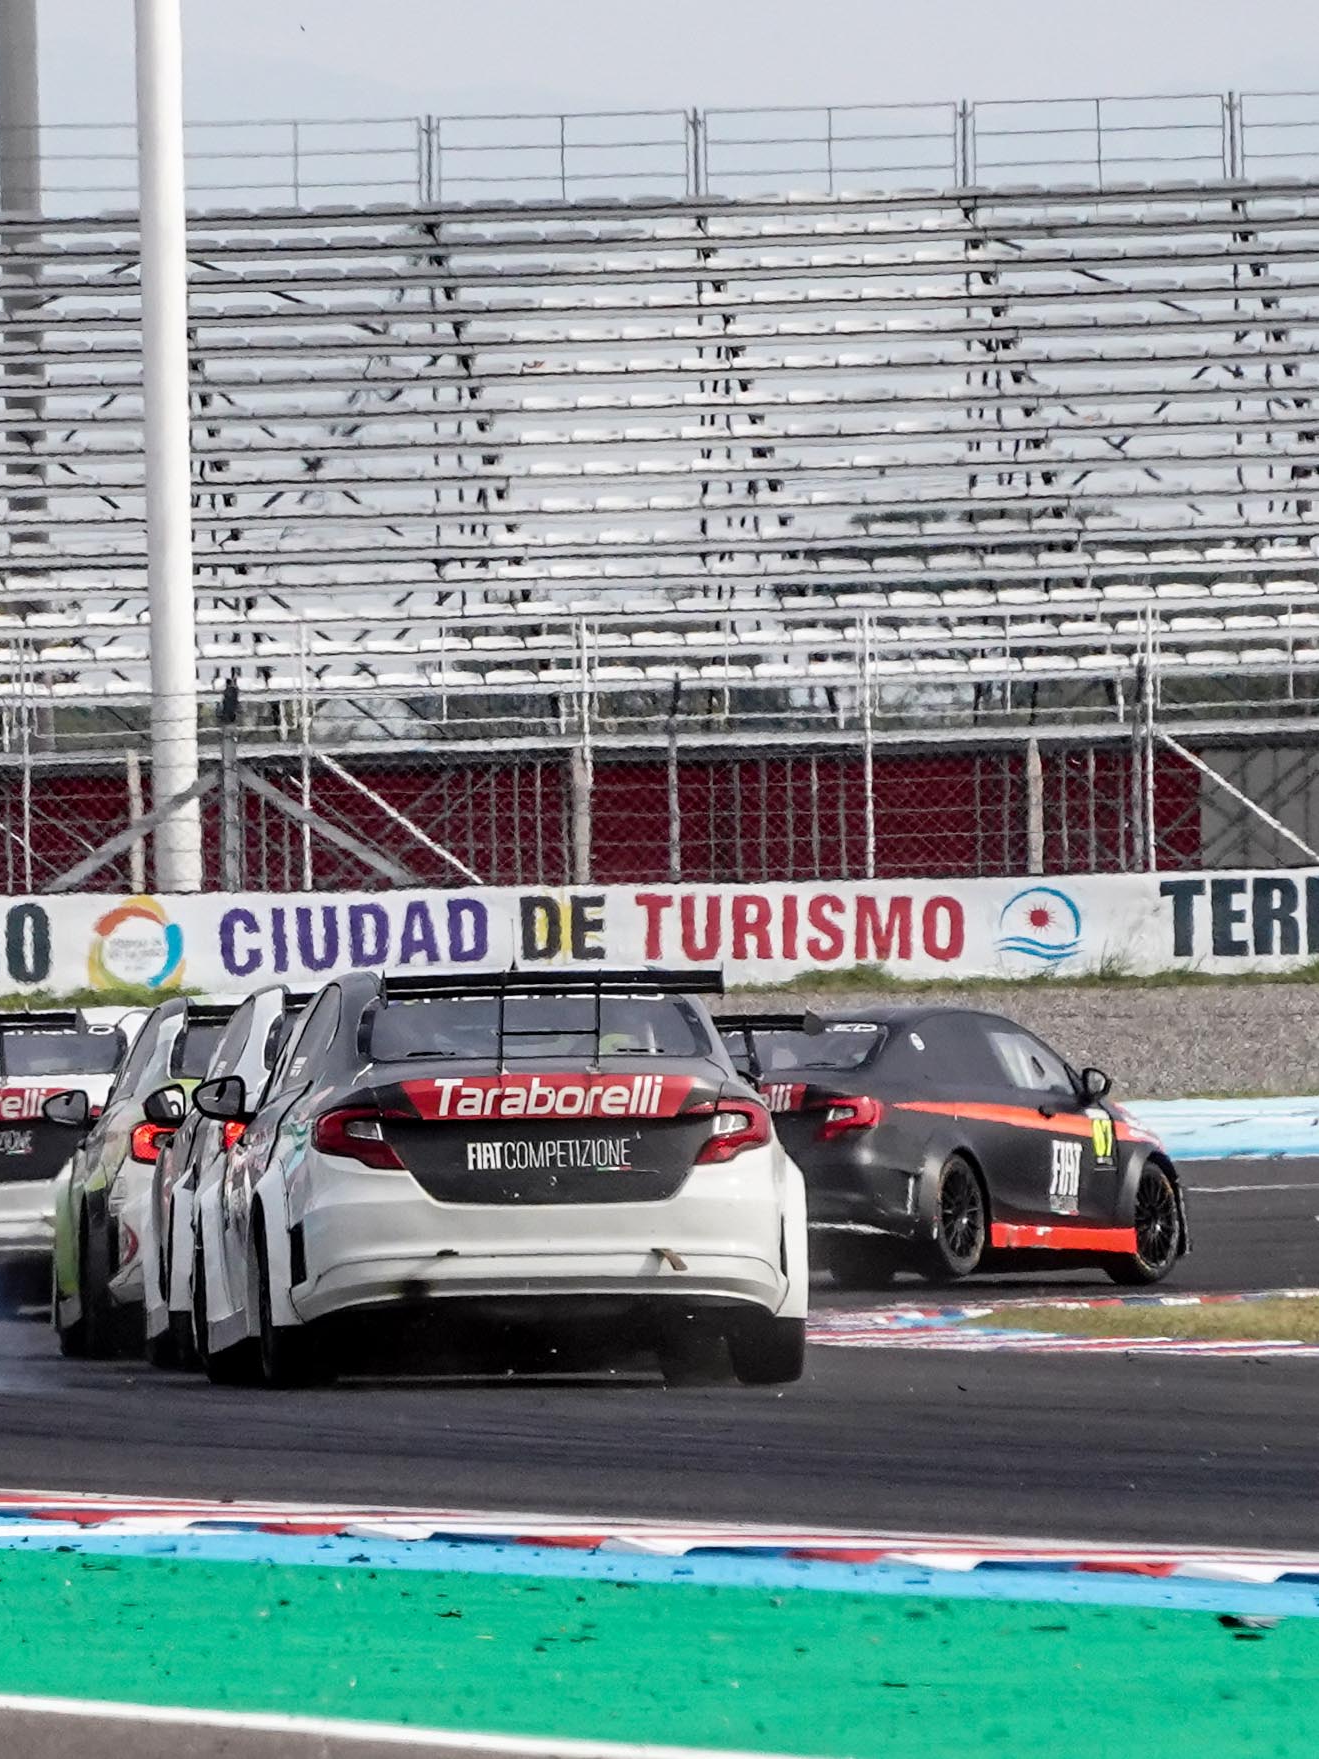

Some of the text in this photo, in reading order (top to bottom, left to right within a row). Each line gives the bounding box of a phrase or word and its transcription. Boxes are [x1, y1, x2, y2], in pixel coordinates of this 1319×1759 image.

[220, 897, 488, 977] CIUDAD
[520, 894, 606, 961] DE
[635, 892, 966, 962] TURISMO
[1160, 876, 1319, 957] TER
[434, 1075, 664, 1117] Taraborelli
